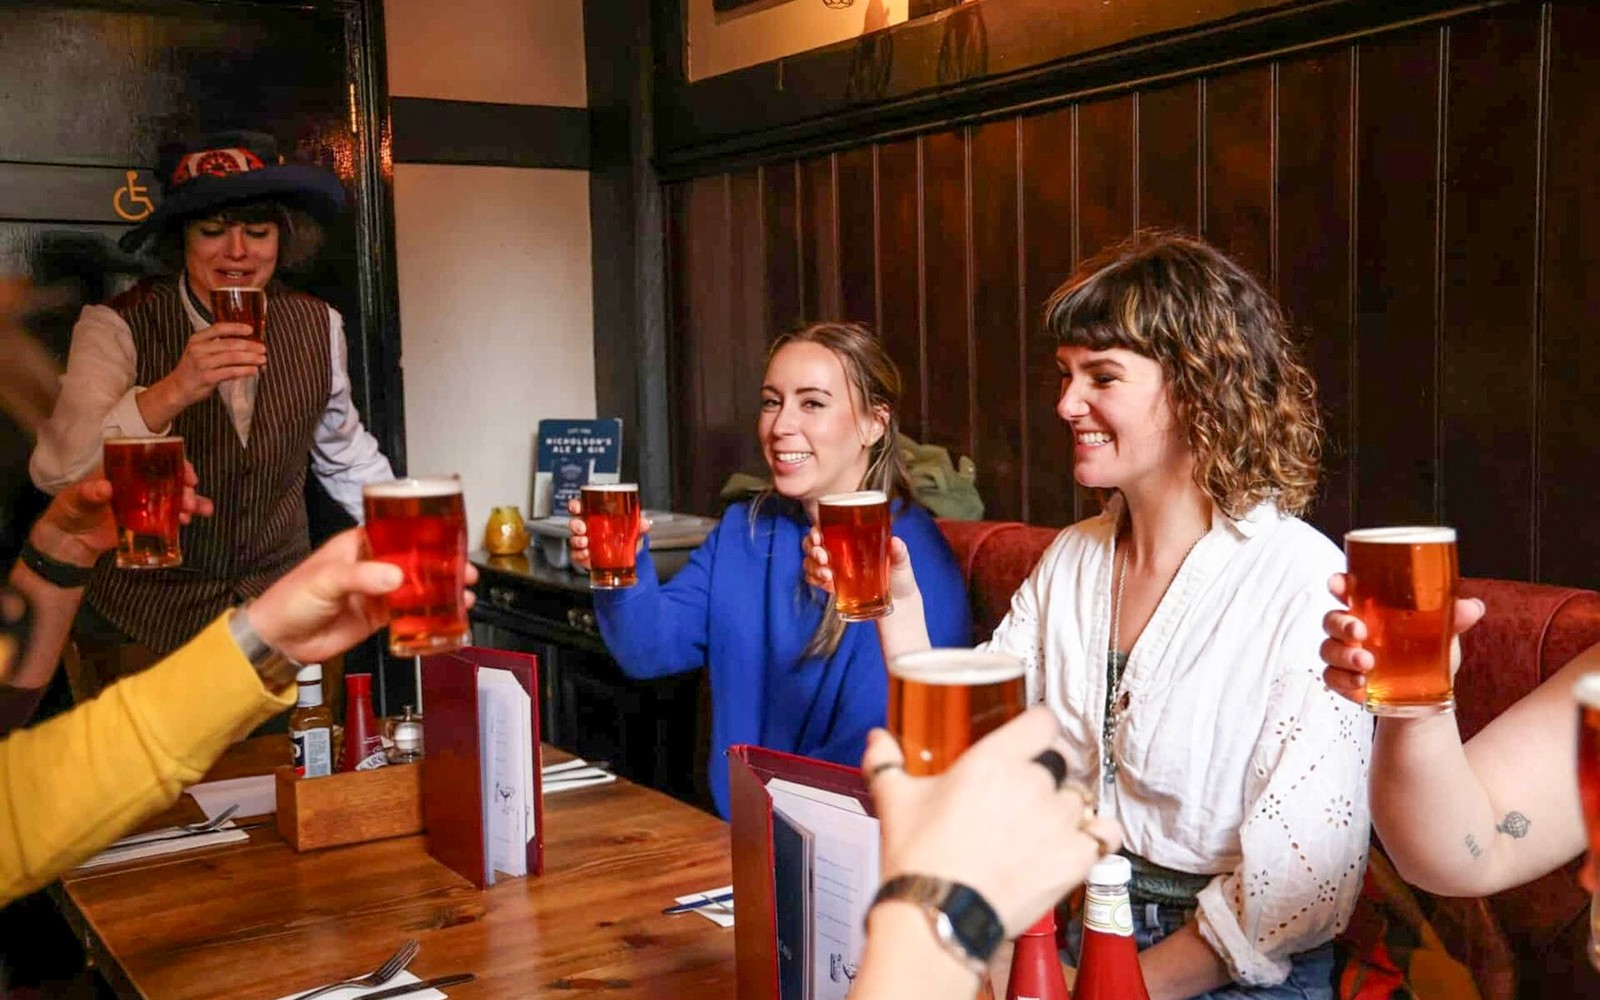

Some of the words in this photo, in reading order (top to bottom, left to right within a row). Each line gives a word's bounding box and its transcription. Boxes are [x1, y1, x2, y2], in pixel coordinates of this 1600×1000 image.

[546, 437, 612, 446] NICHOLSON'S
[552, 446, 571, 454] ALE
[587, 446, 606, 454] GIN
